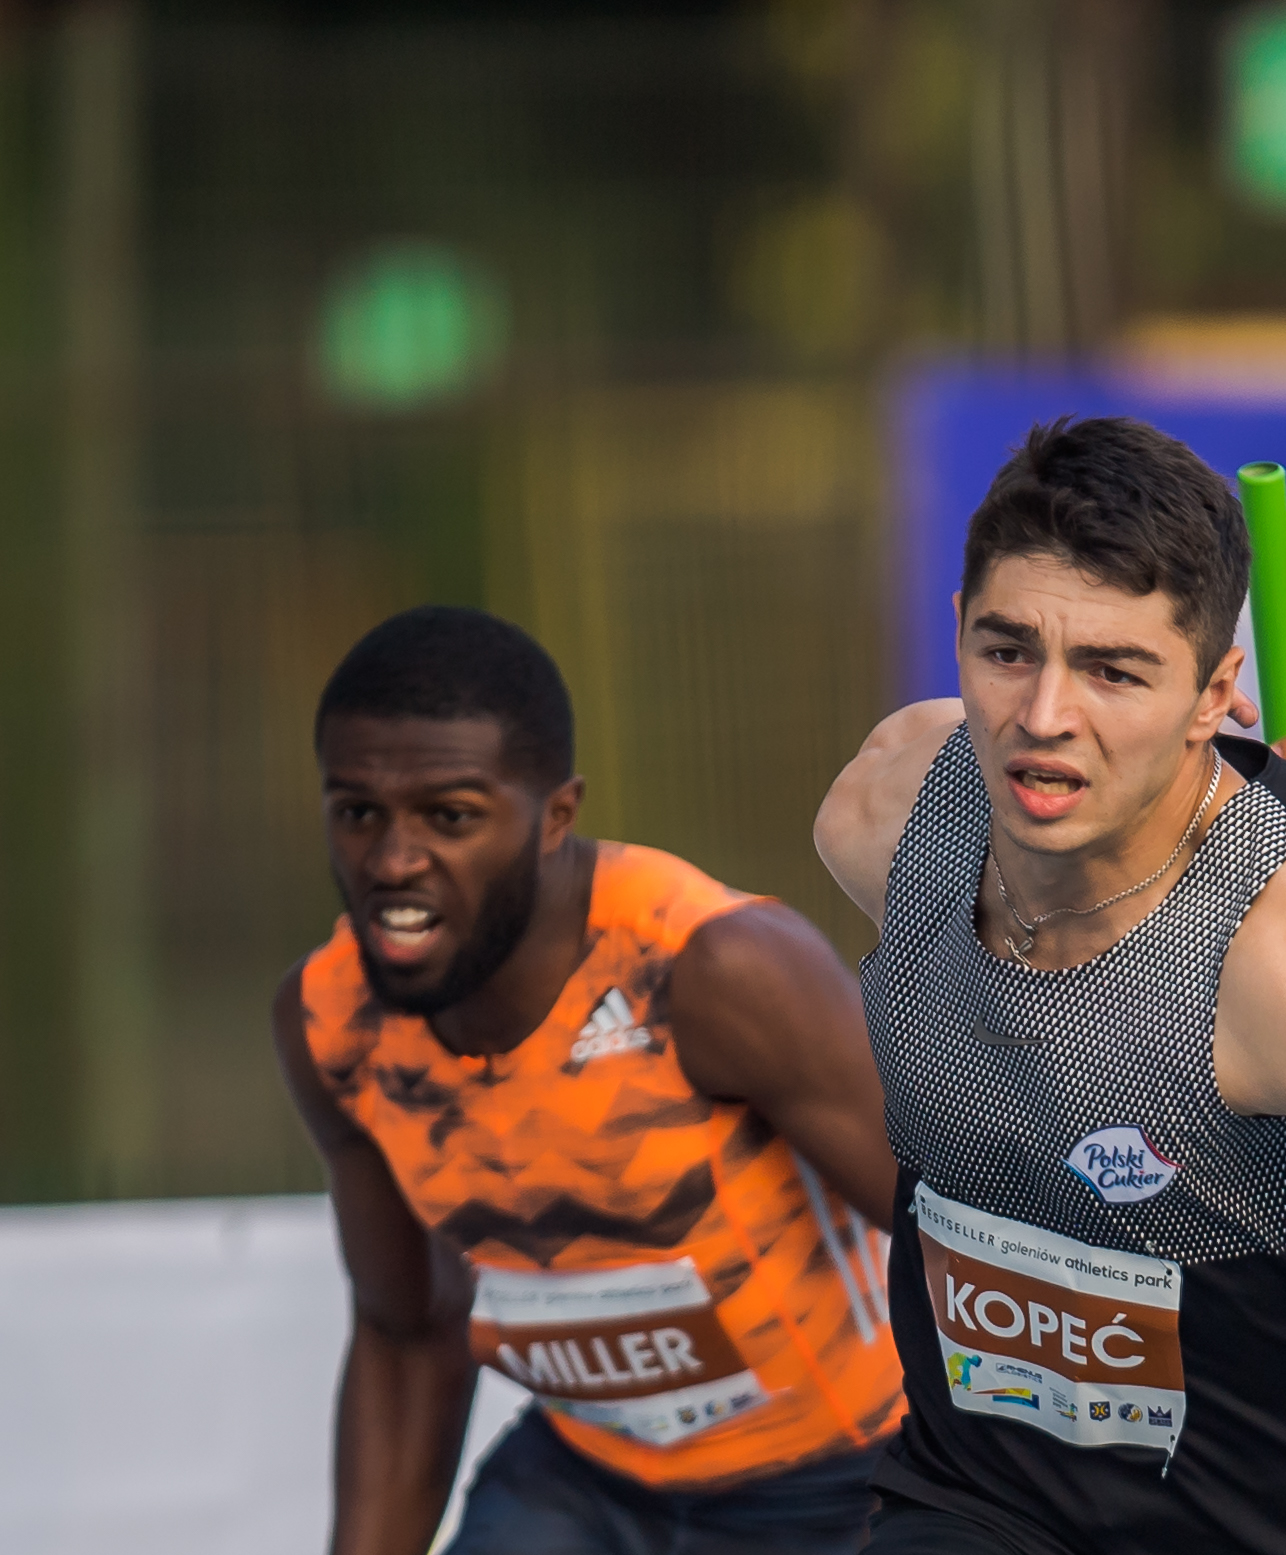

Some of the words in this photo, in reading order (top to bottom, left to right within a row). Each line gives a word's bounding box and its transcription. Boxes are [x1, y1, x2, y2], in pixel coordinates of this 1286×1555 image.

[1083, 1143, 1145, 1170] Polski
[1098, 1166, 1164, 1189] Cukier
[920, 1203, 995, 1246] BESTSELLER
[1001, 1240, 1061, 1265] goleniów
[1065, 1257, 1129, 1282] athletics
[1134, 1273, 1173, 1290] park
[945, 1273, 1146, 1369] KOPEĆ
[496, 1326, 705, 1387] MILLER
